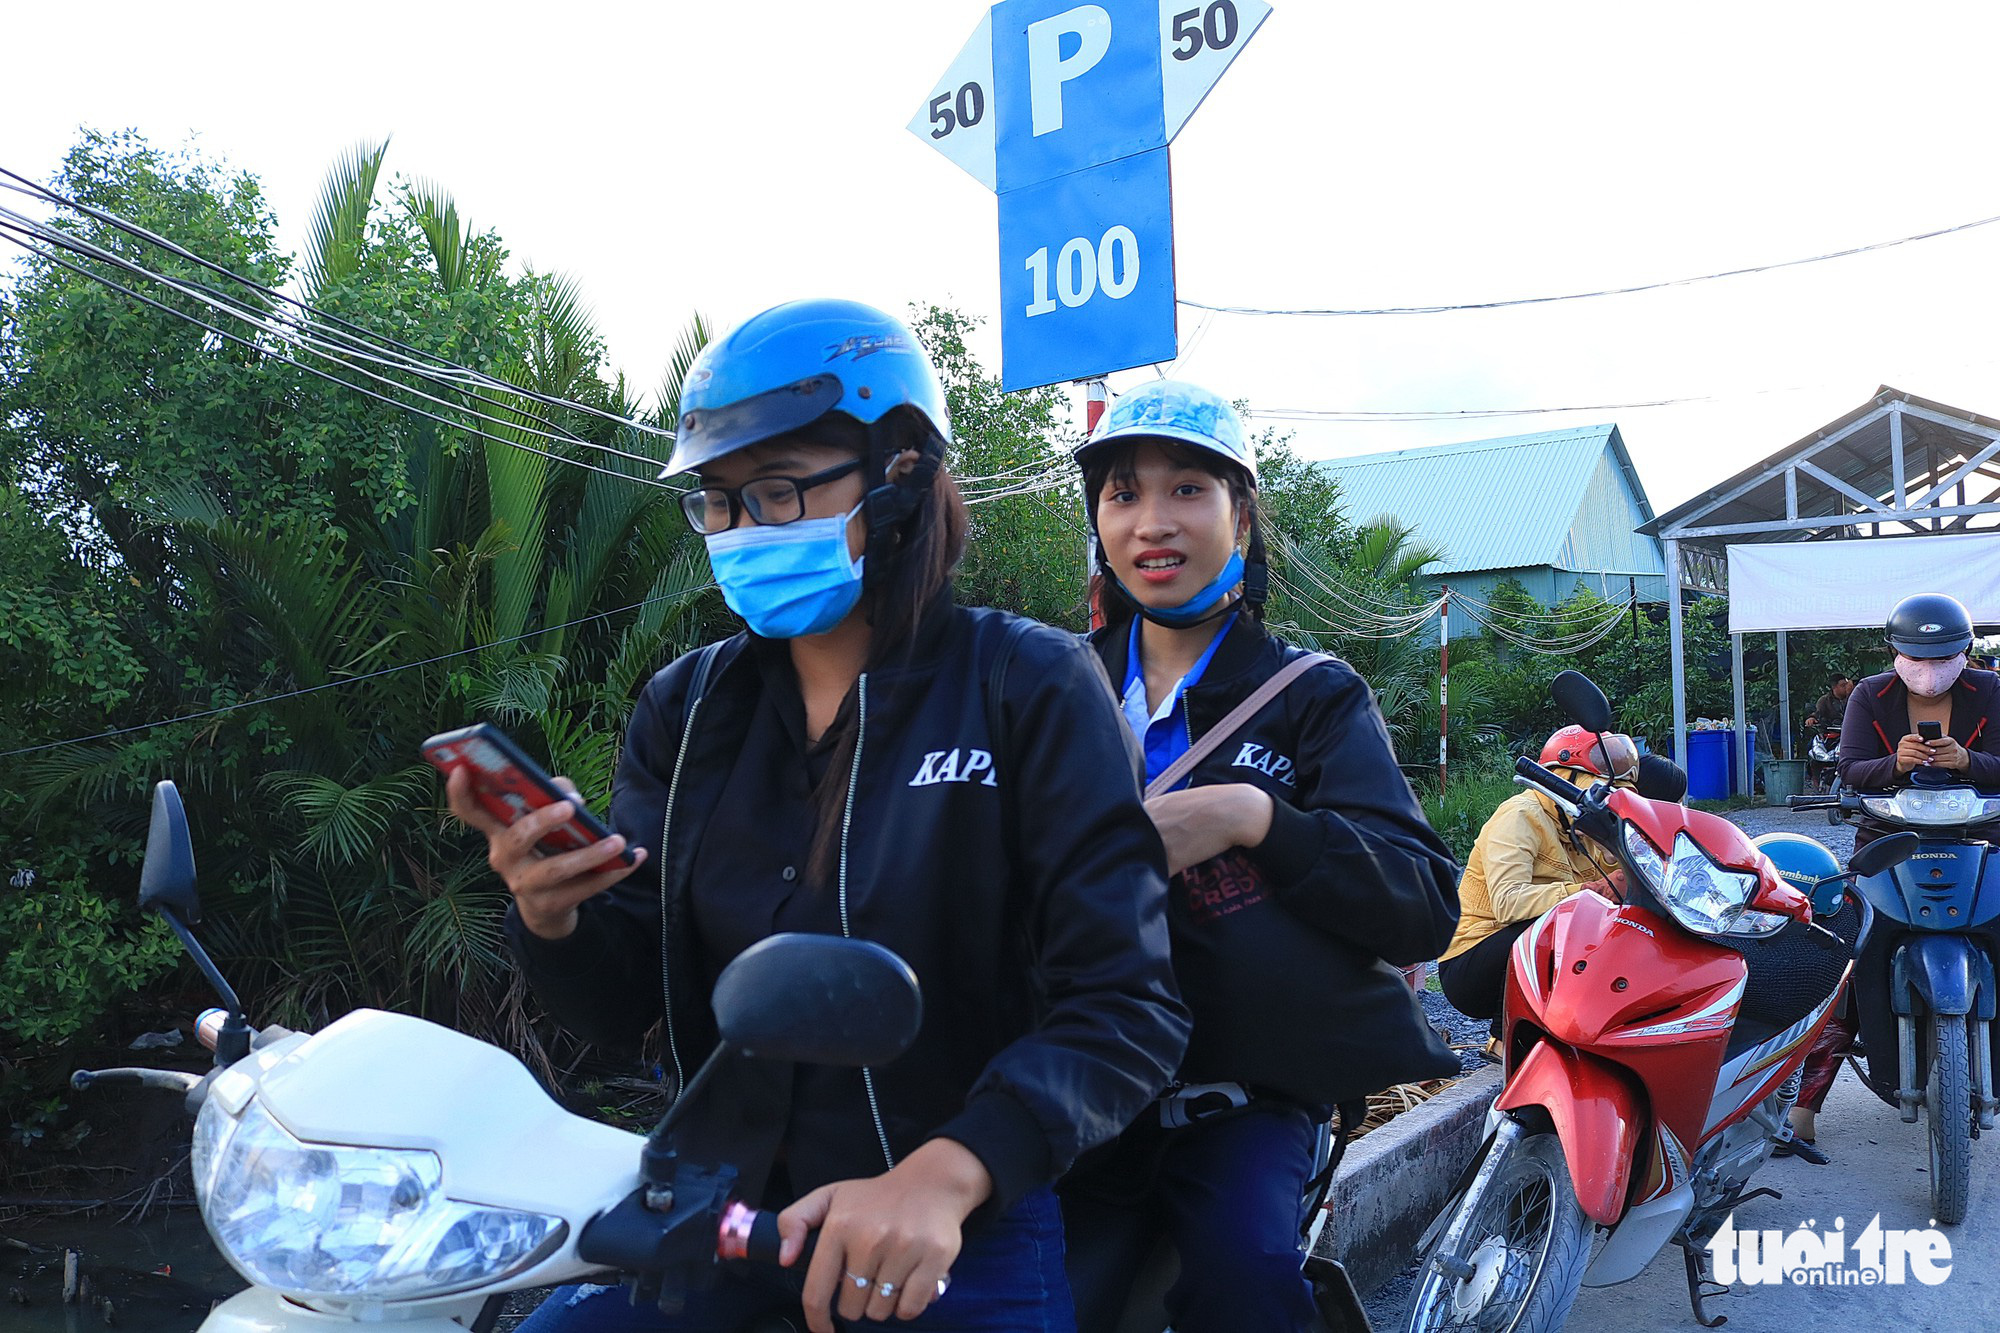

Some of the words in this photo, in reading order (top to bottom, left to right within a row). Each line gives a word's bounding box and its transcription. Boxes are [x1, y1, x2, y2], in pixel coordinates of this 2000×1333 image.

[1172, 0, 1239, 61] 50
[1027, 4, 1112, 138] P
[929, 81, 984, 140] 50
[1025, 225, 1140, 318] 100
[1776, 868, 1821, 883] ombank
[1911, 852, 1958, 860] HONDA
[1613, 916, 1655, 938] HONDA
